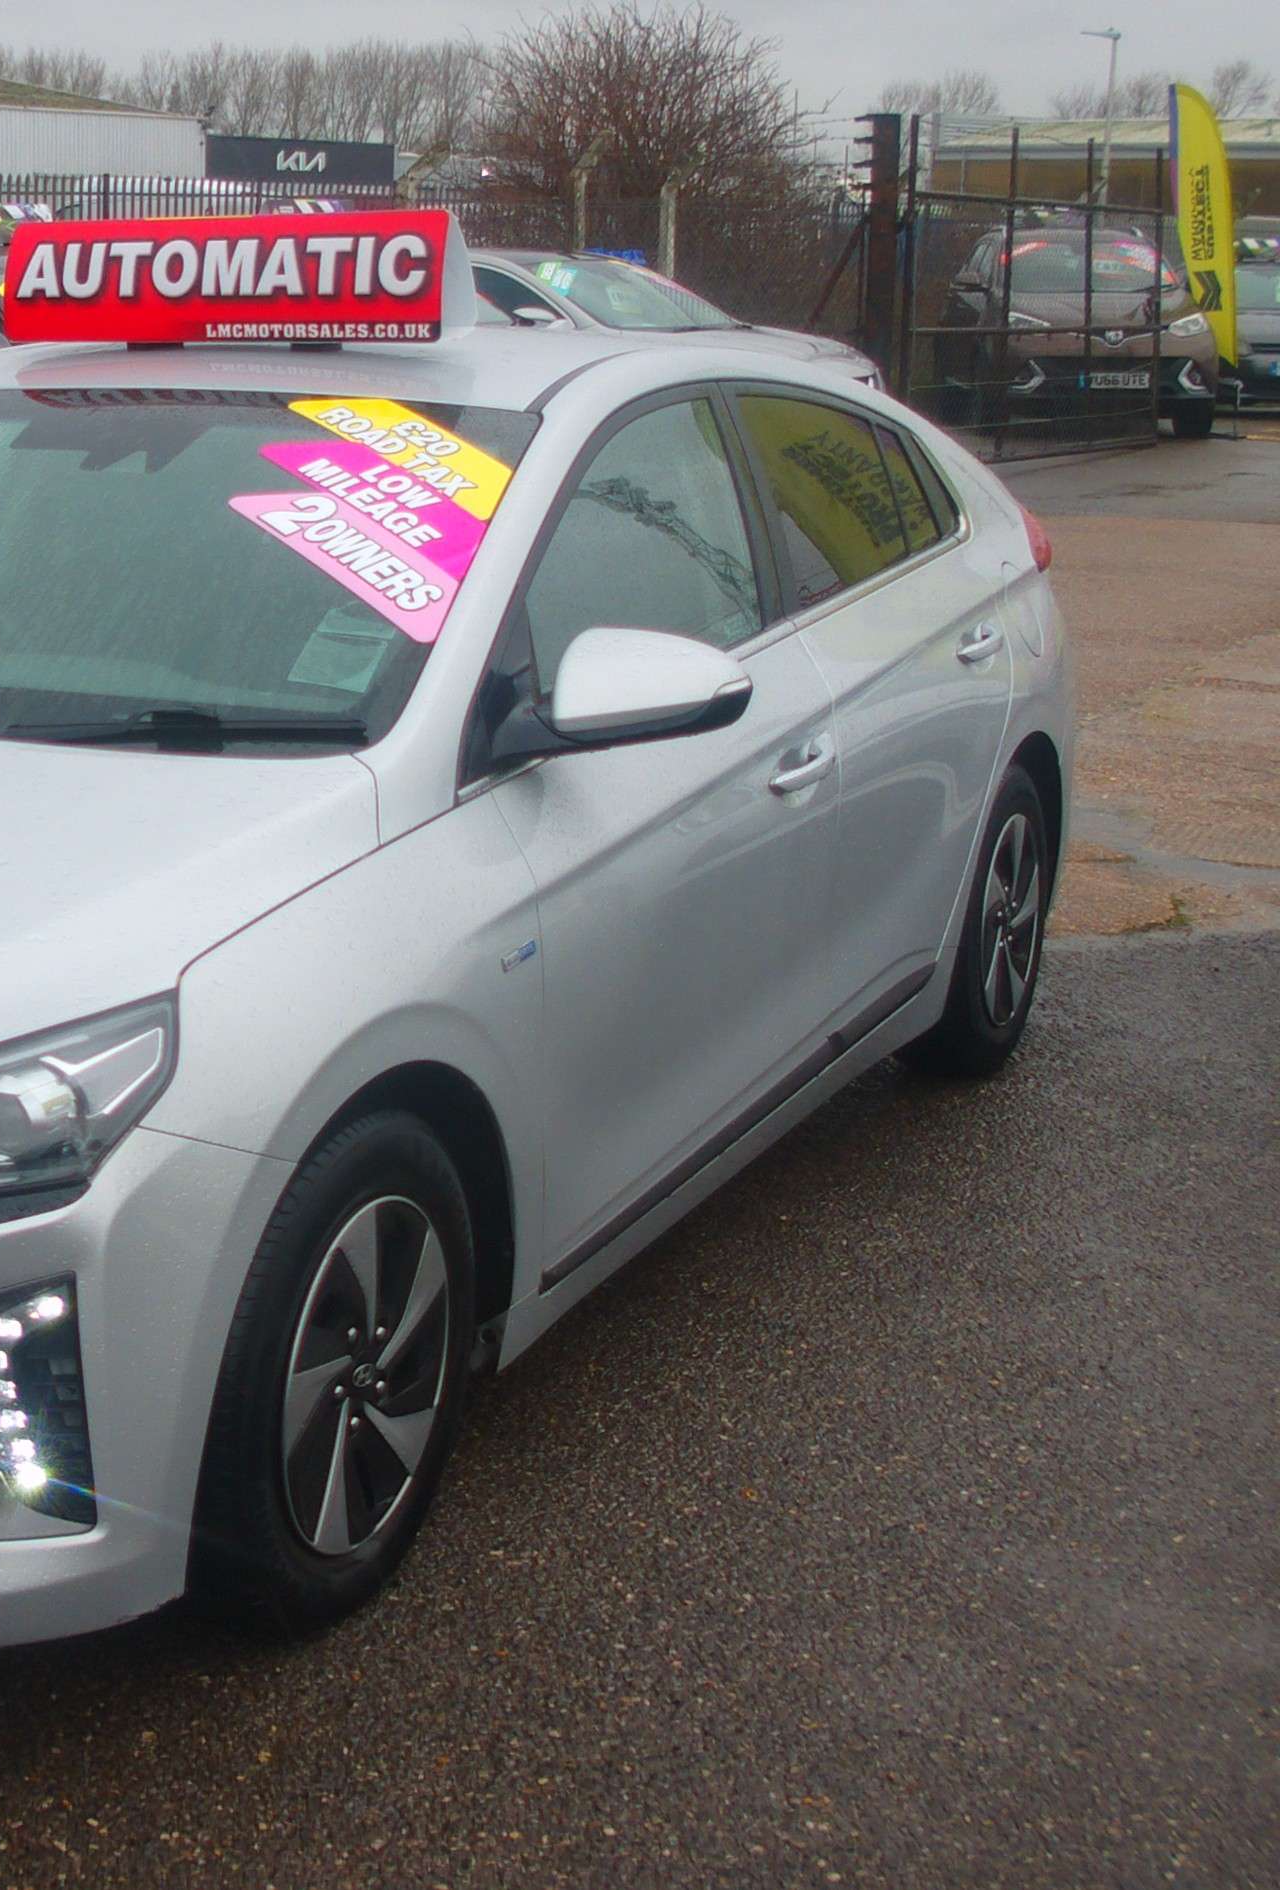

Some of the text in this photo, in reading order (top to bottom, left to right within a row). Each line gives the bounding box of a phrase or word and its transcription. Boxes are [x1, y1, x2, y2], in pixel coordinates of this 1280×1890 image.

[277, 150, 326, 172] KIA
[16, 234, 427, 299] AUTOMATIC
[205, 323, 431, 339] LMCMOTORSALES.CO.UK
[316, 406, 478, 497] ROAD TAX
[391, 420, 461, 457] £20
[297, 457, 443, 548] MILEAGE
[358, 464, 442, 510] LOW
[257, 495, 444, 611] 2 OWNERS
